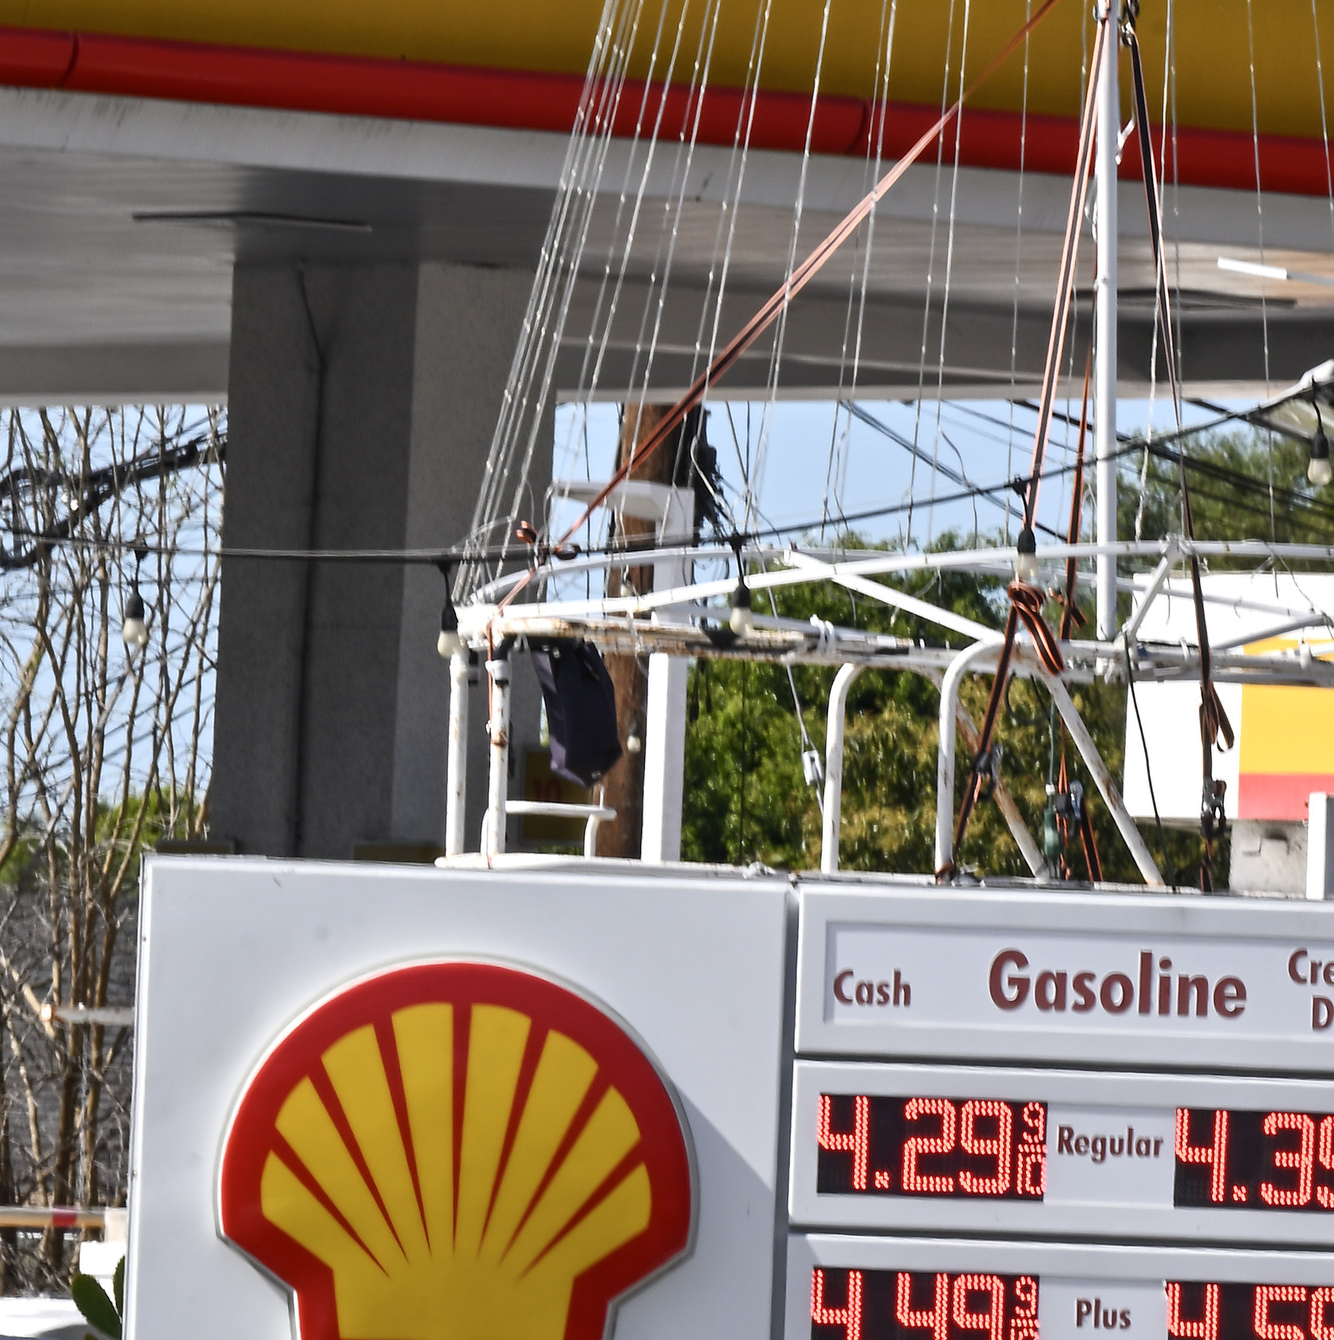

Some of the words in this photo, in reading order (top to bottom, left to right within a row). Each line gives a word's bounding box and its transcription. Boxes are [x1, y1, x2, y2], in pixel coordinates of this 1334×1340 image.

[833, 969, 912, 1008] Cash
[988, 948, 1248, 1019] Gasoline
[1057, 1125, 1164, 1161] Regular
[1075, 1297, 1132, 1331] Plus
